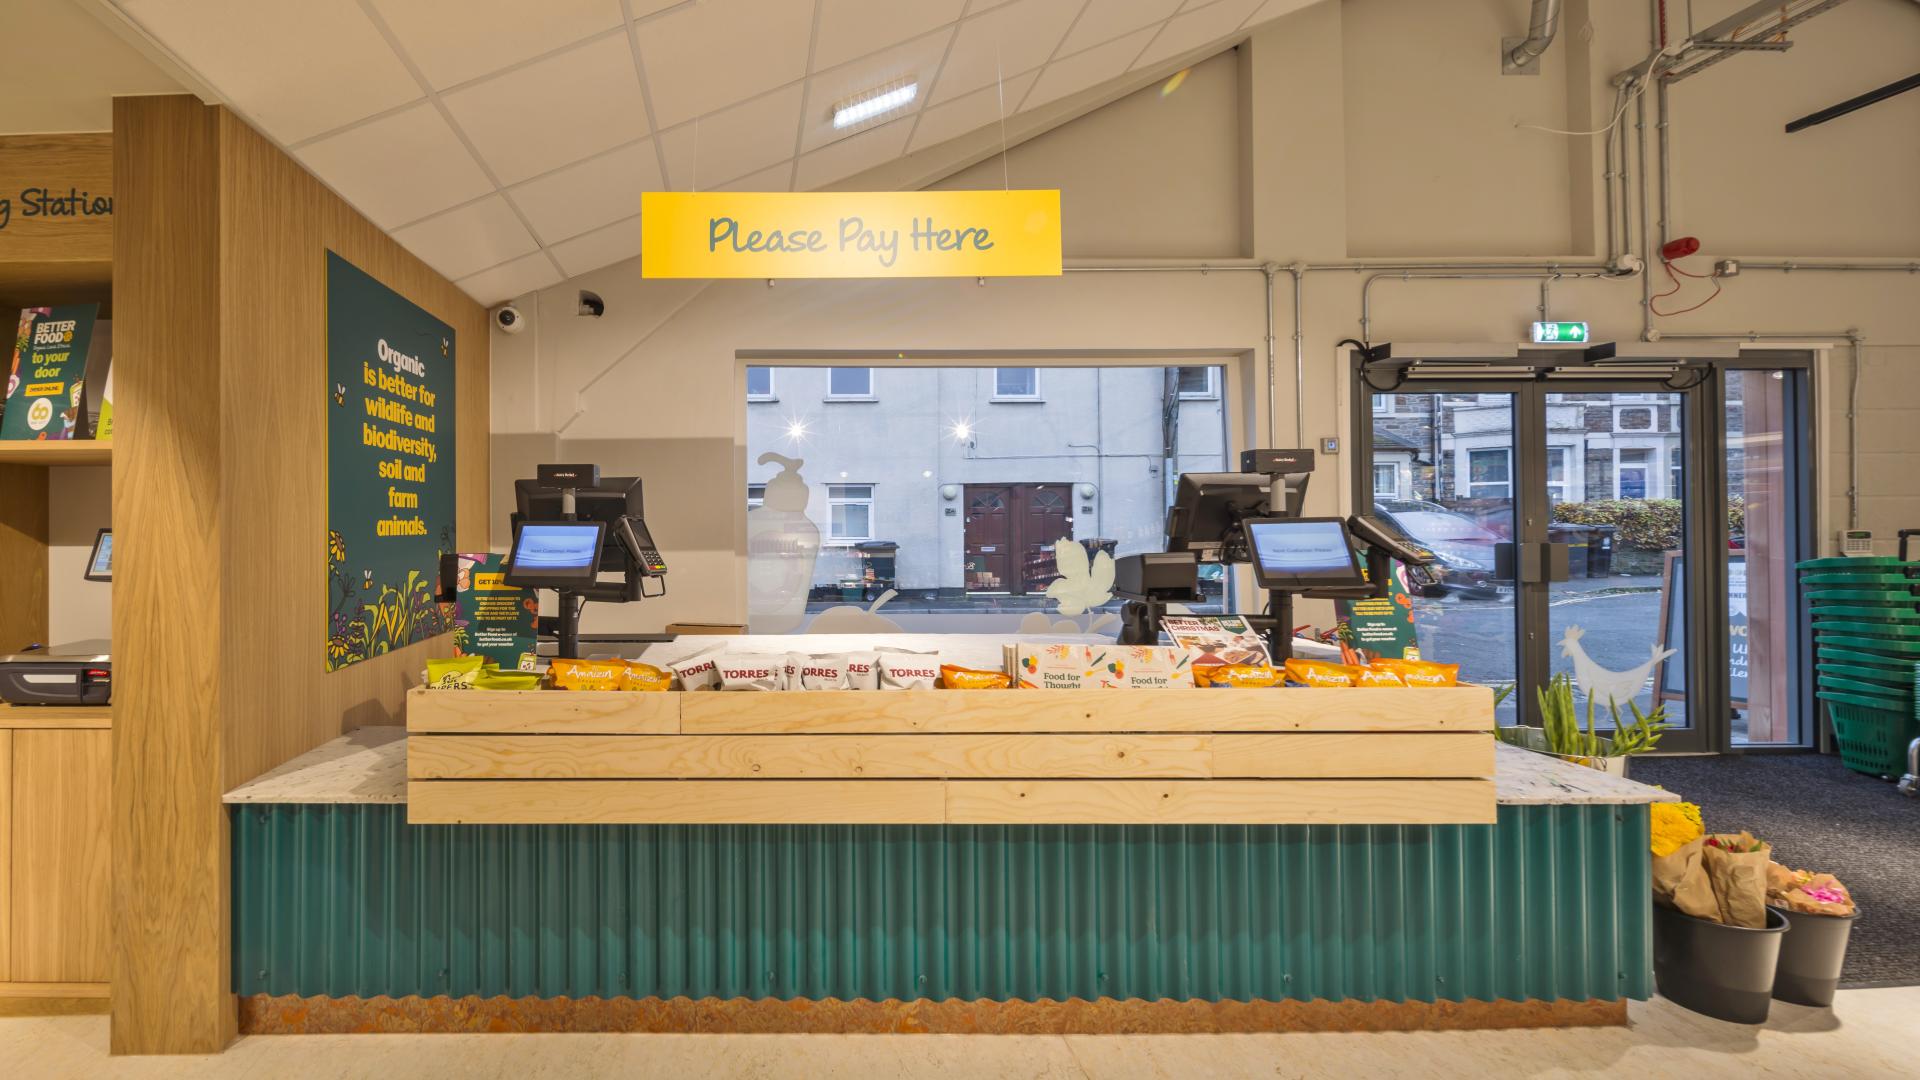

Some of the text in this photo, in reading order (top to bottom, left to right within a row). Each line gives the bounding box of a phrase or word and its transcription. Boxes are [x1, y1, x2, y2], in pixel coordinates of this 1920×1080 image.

[709, 216, 996, 268] Please Pay Here
[36, 320, 76, 334] BETTER
[34, 332, 64, 345] FOOD
[32, 352, 70, 366] to your
[377, 338, 425, 378] Organic
[34, 366, 62, 379] door
[363, 361, 436, 408] is better for
[364, 396, 435, 433] wildlife and
[363, 422, 437, 463] biodiversity,
[378, 459, 426, 483] soil and
[388, 486, 418, 509] farm
[376, 515, 428, 537] animals.
[680, 662, 716, 679] TORR
[723, 669, 769, 679] TORRES
[802, 667, 838, 679] ORRES
[889, 668, 936, 678] TORRES
[1043, 672, 1081, 682] Food for
[1131, 676, 1168, 685] Food for
